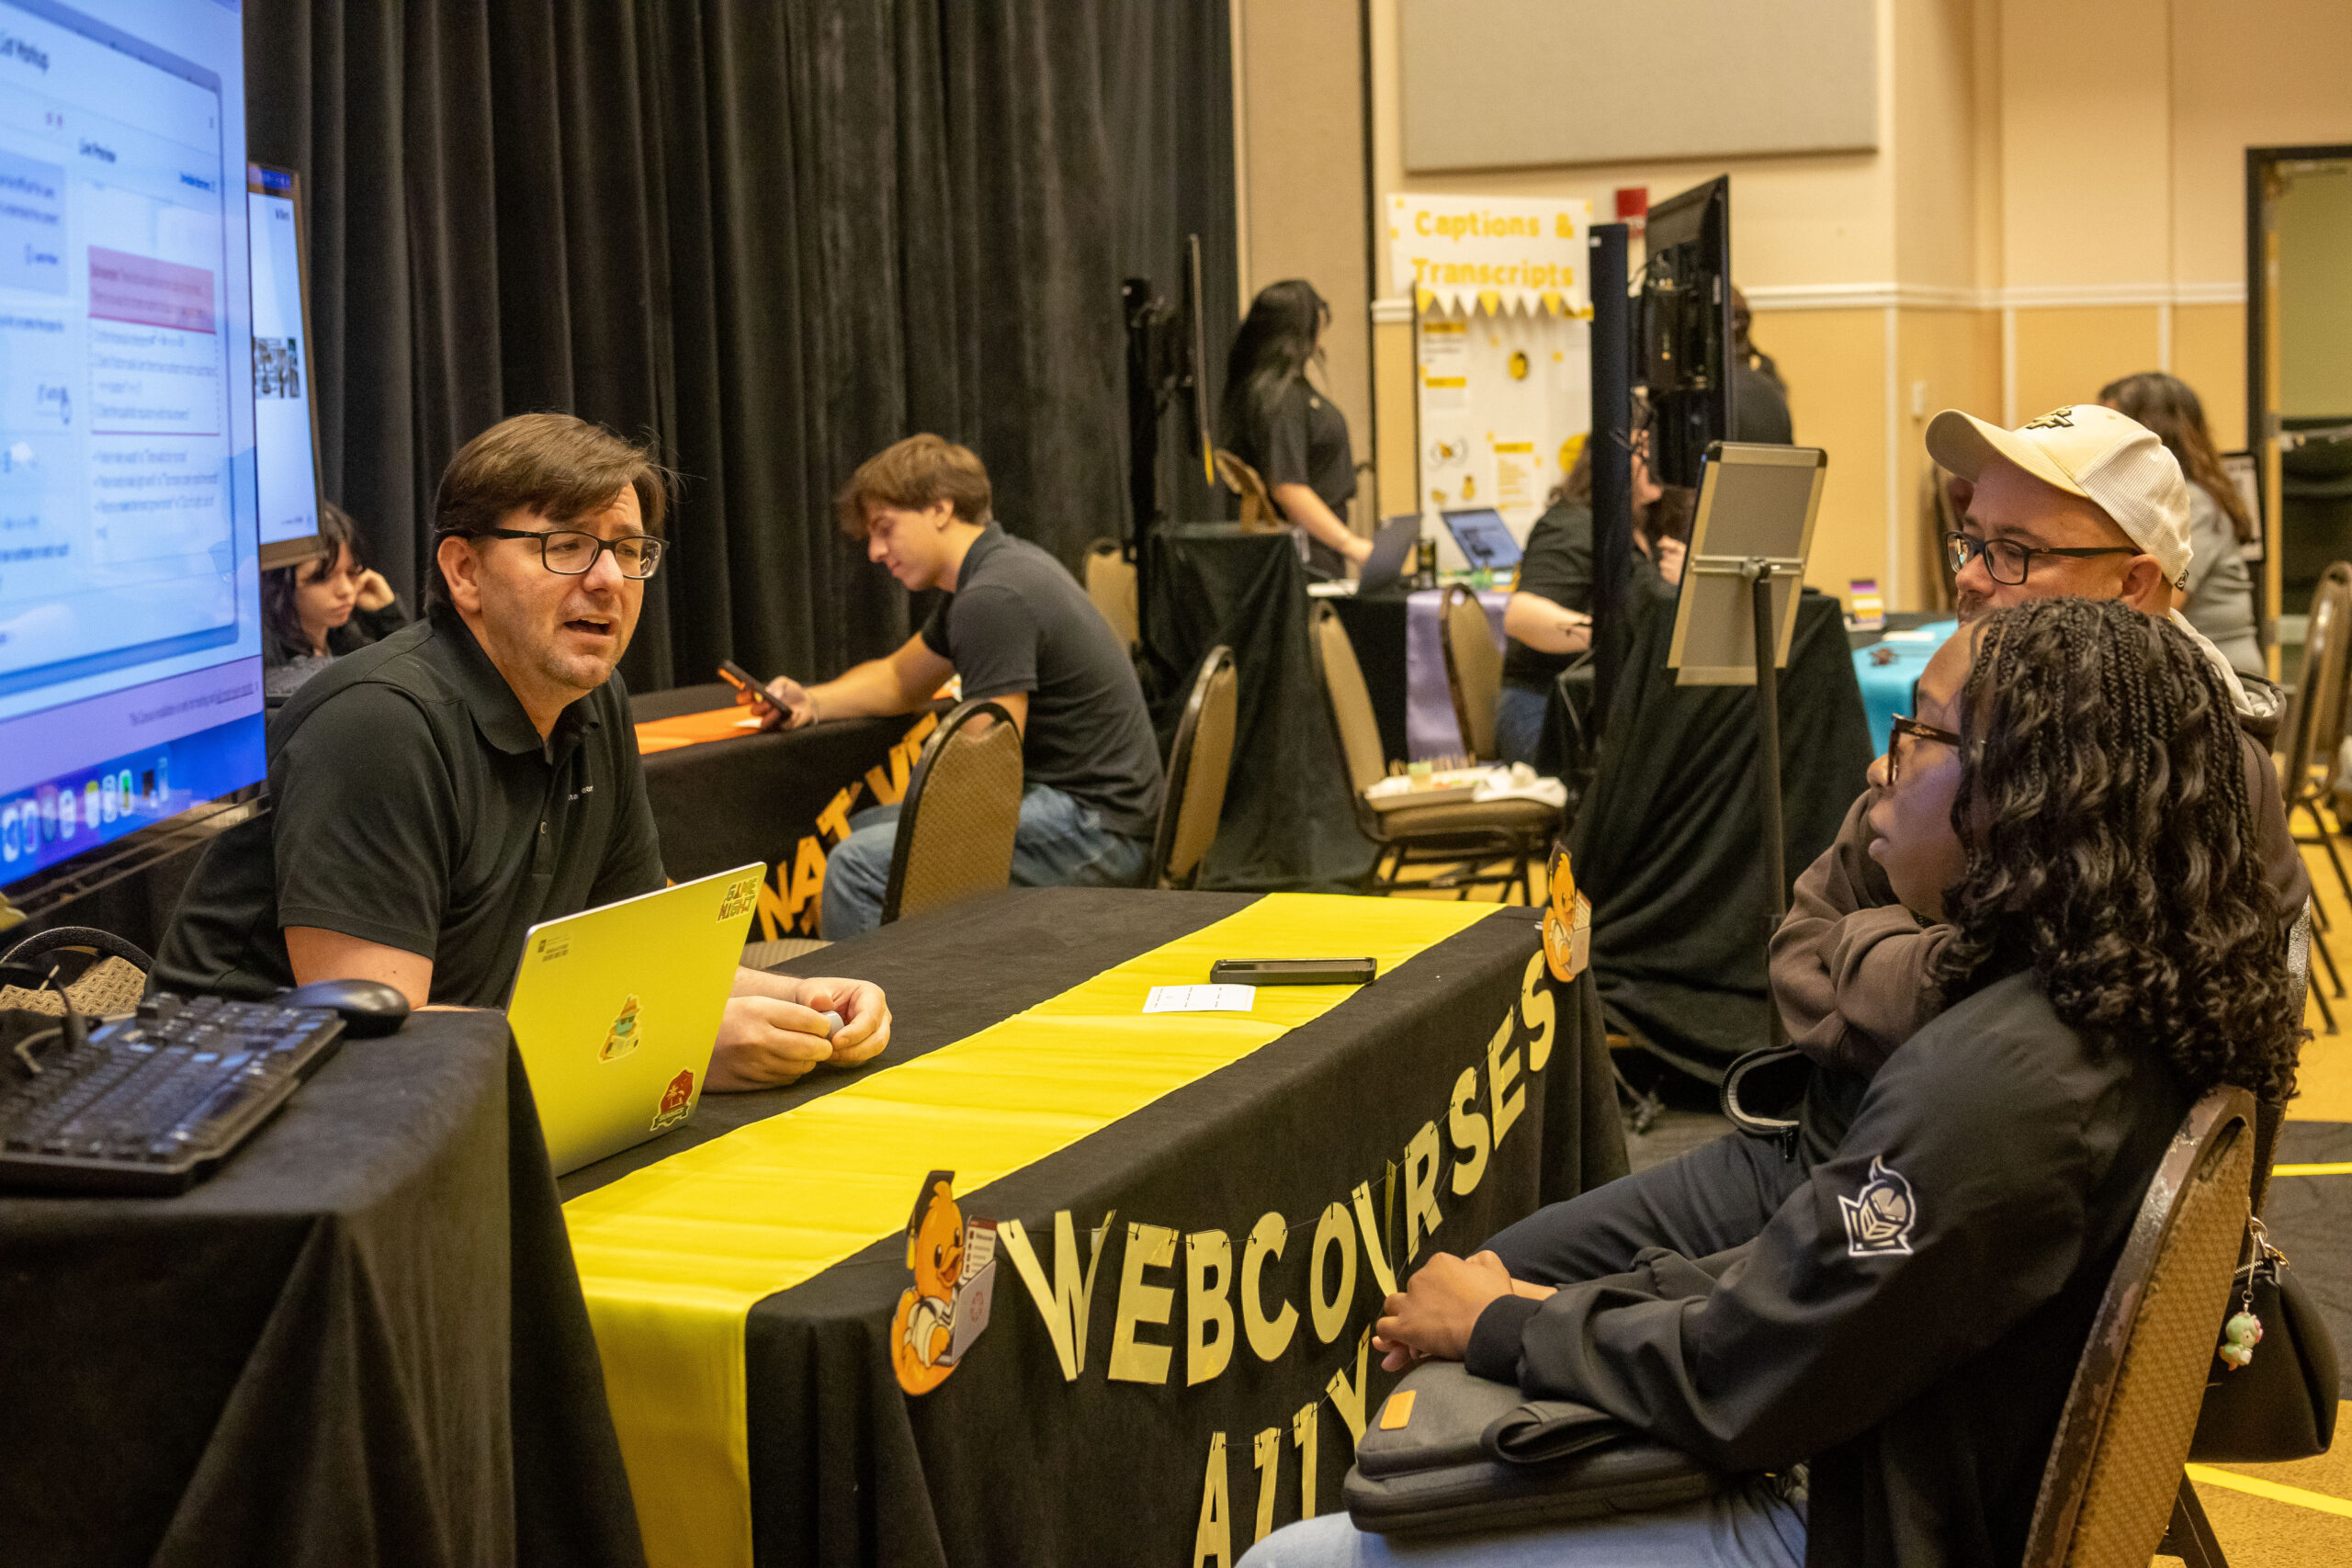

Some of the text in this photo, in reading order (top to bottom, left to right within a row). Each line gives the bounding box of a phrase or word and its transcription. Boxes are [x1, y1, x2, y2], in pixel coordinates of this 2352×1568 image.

[1415, 210, 1575, 242] Captions &
[1411, 258, 1574, 289] Transcripts
[757, 711, 938, 942] NATV
